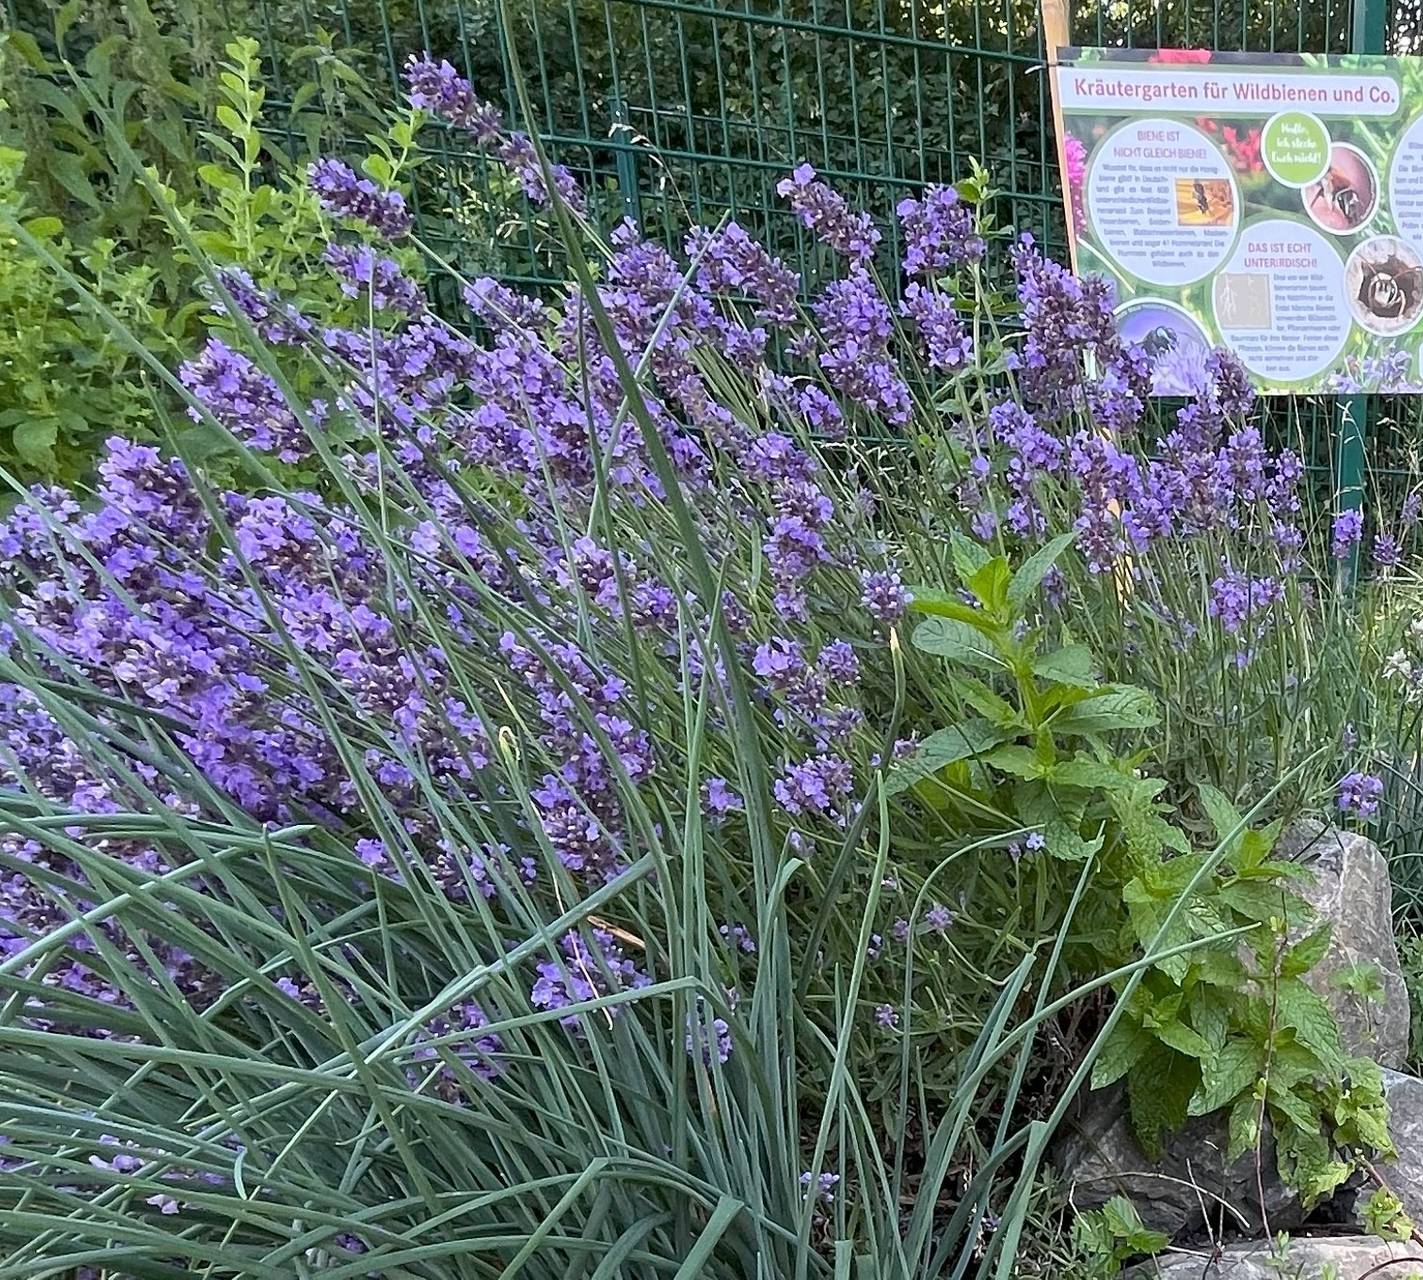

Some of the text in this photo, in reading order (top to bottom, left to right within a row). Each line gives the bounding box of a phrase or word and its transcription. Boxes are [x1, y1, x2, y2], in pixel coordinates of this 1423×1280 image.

[1075, 78, 1395, 103] Kräutergarten für Wildbienen und Co.
[1137, 131, 1180, 141] BIENE IST
[1114, 147, 1142, 158] NICHT
[1143, 148, 1176, 158] GLEICH
[1248, 243, 1312, 253] DAS IST ECHT
